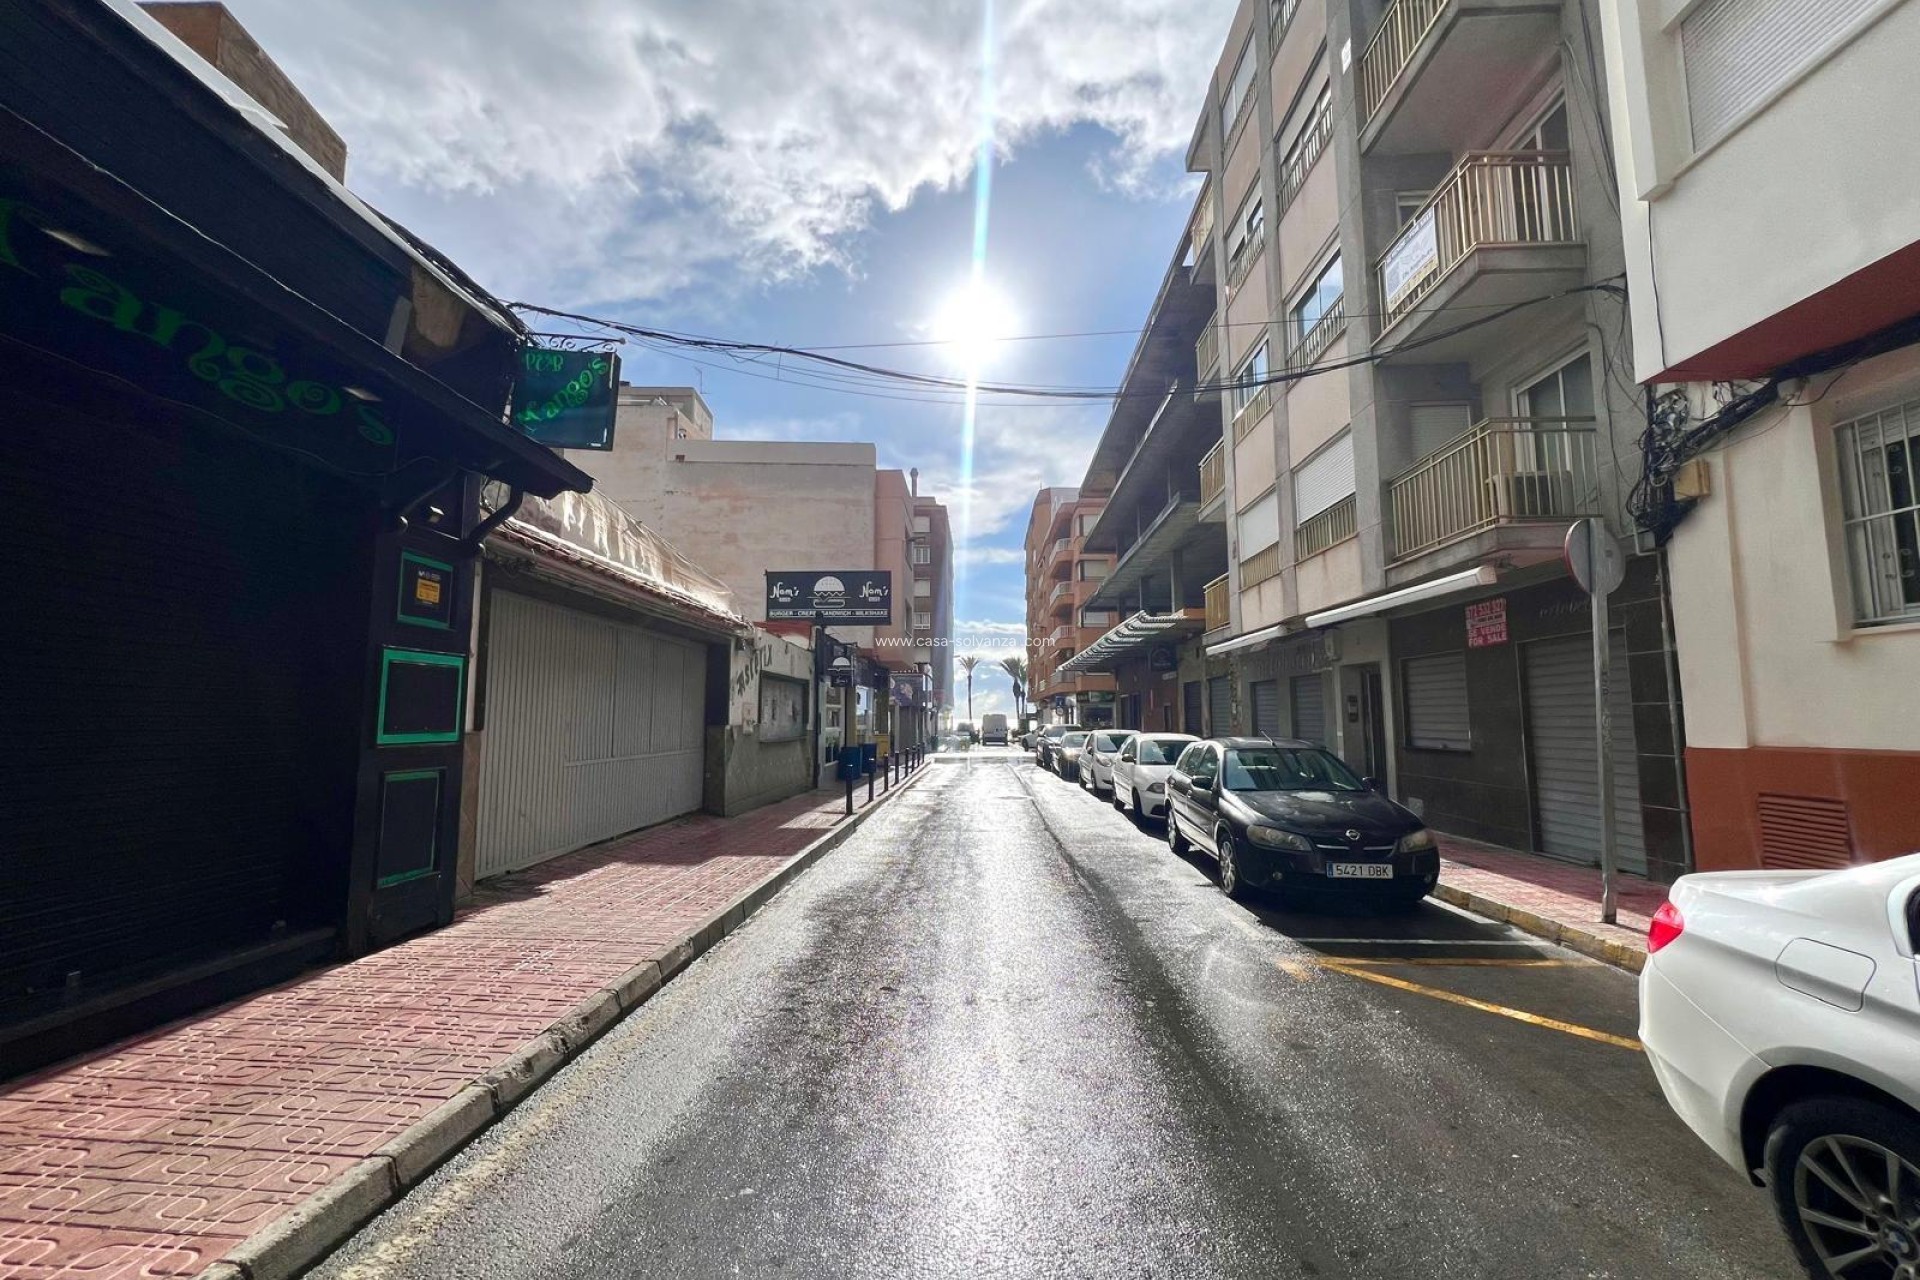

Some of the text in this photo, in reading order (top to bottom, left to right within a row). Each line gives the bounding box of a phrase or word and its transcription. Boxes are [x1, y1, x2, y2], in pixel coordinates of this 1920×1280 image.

[1481, 622, 1507, 635] VENDE
[1468, 631, 1507, 648] FOR SALE
[1336, 865, 1389, 876] 5421 DBK
